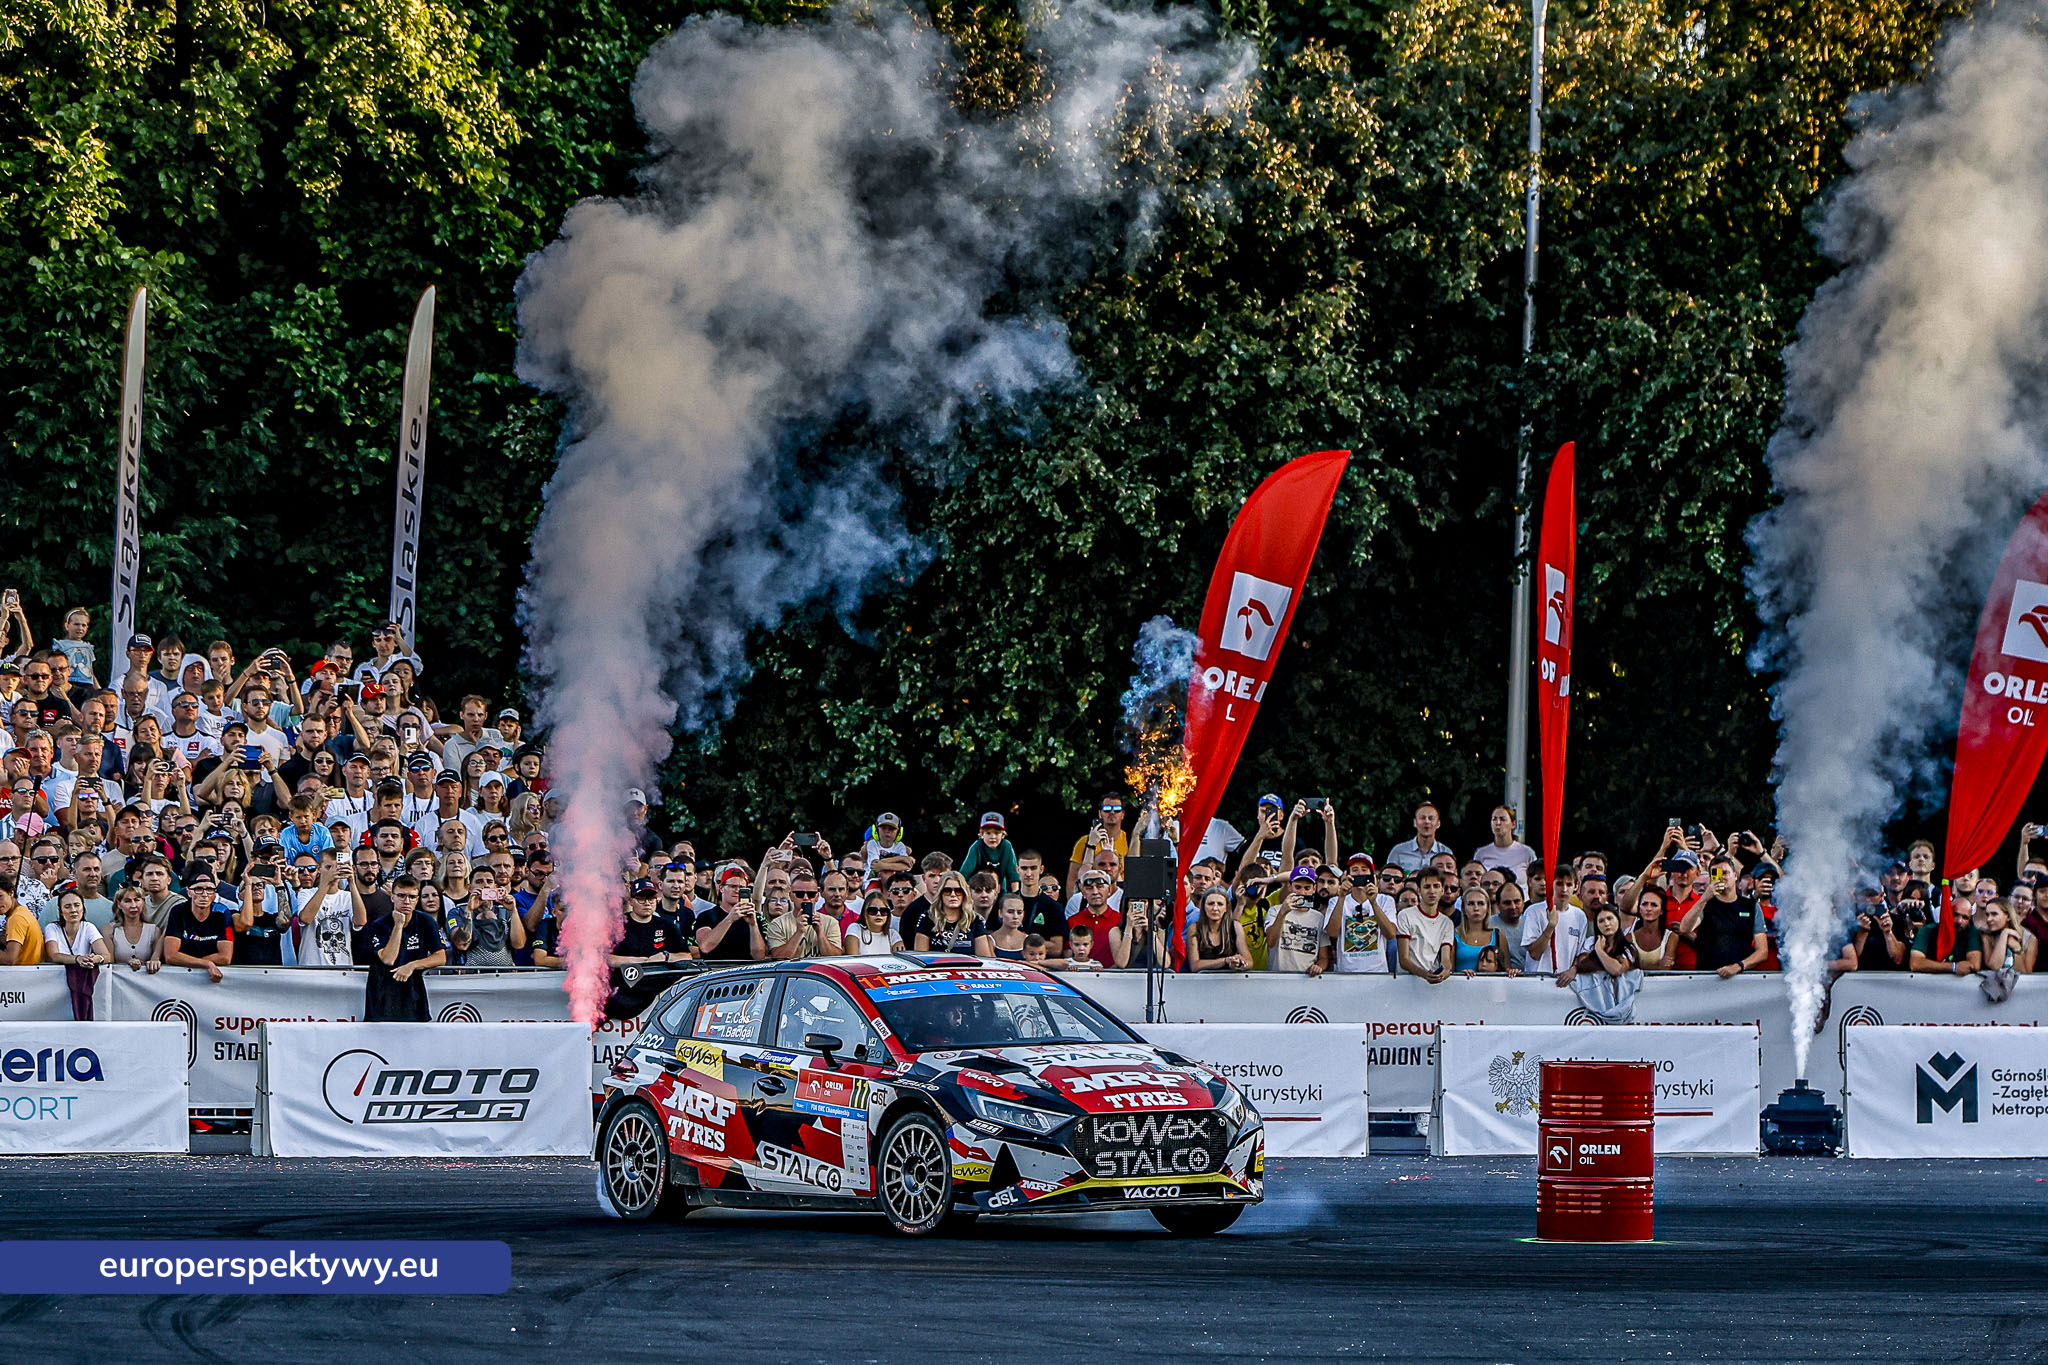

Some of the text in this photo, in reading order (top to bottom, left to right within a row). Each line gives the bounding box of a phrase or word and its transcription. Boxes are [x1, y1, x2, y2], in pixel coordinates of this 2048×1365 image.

[885, 971, 953, 985] MRF
[958, 971, 1026, 981] TYRES
[694, 1003, 719, 1037] 11
[214, 1042, 259, 1061] STAD
[1022, 1051, 1151, 1066] STALCO
[1367, 1047, 1422, 1066] ADION
[0, 1048, 104, 1083] eria
[1991, 1067, 2048, 1082] Górnośl
[372, 1068, 539, 1096] MOTO
[1061, 1071, 1187, 1094] MRF
[1655, 1079, 1714, 1099] rystyki
[662, 1079, 737, 1127] MRF
[825, 1080, 868, 1109] ORLEN 11
[1103, 1091, 1189, 1109] TYRES
[368, 1101, 525, 1121] WIZJA
[668, 1114, 726, 1152] TYRES
[1579, 1144, 1621, 1155] ORLEN
[762, 1145, 841, 1192] STALCO
[1095, 1147, 1210, 1176] STALCO
[1579, 1156, 1596, 1165] OIL
[1020, 1179, 1058, 1193] MRF
[1123, 1186, 1181, 1199] YACCO
